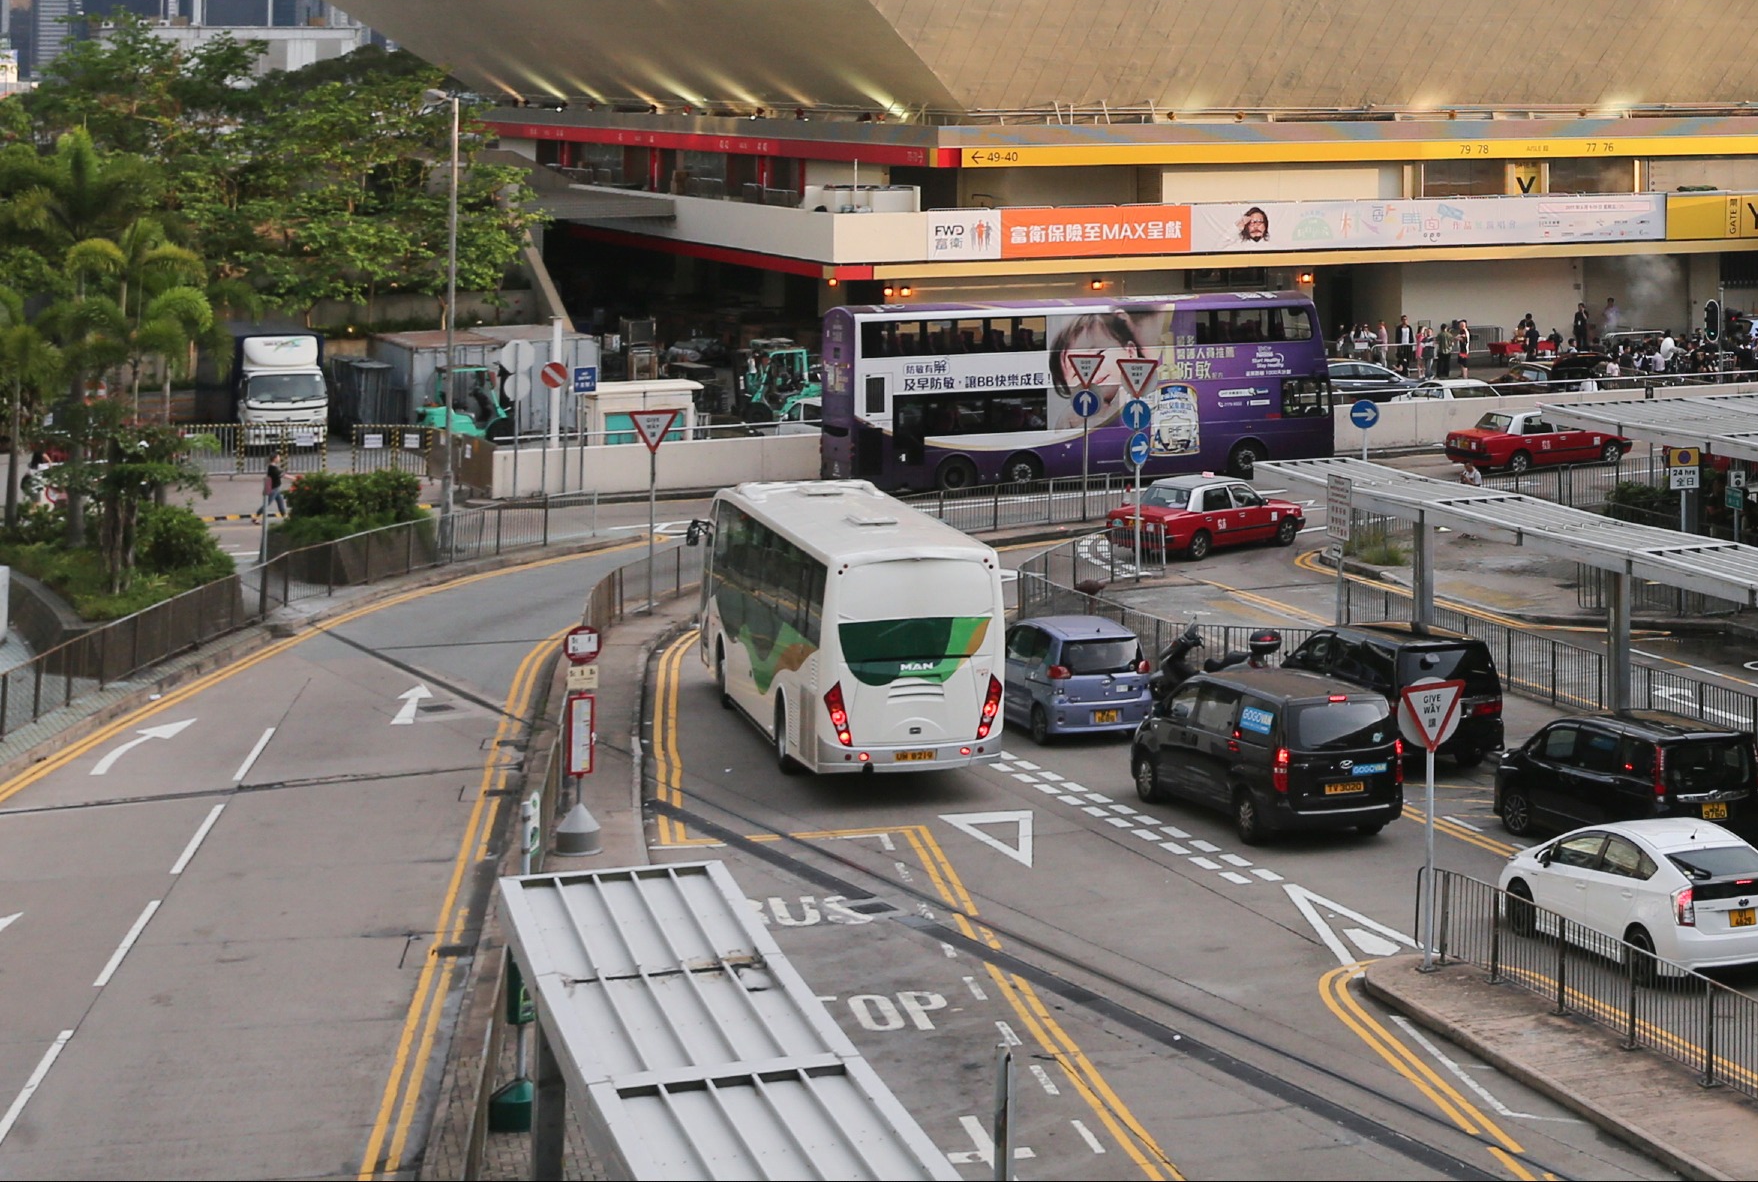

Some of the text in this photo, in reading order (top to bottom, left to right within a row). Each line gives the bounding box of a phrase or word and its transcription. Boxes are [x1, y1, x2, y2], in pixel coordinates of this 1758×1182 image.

[1460, 144, 1471, 155] 79
[1478, 144, 1489, 154] 78
[1586, 143, 1597, 153] 77
[1603, 142, 1614, 152] 76
[987, 151, 1018, 163] 49-40
[935, 225, 965, 236] FWD
[1010, 220, 1182, 245] 富衛保險至MAX呈獻
[1673, 468, 1696, 477] 24 hrs
[1676, 478, 1694, 487] 全日
[900, 661, 934, 671] MAN
[1423, 694, 1441, 704] GIVE
[1423, 704, 1441, 715] WAY
[1243, 707, 1273, 726] GOGOVAN
[1353, 763, 1387, 774] GOGOVAN
[1327, 781, 1362, 793] TV 3020
[1704, 809, 1726, 819] 9760
